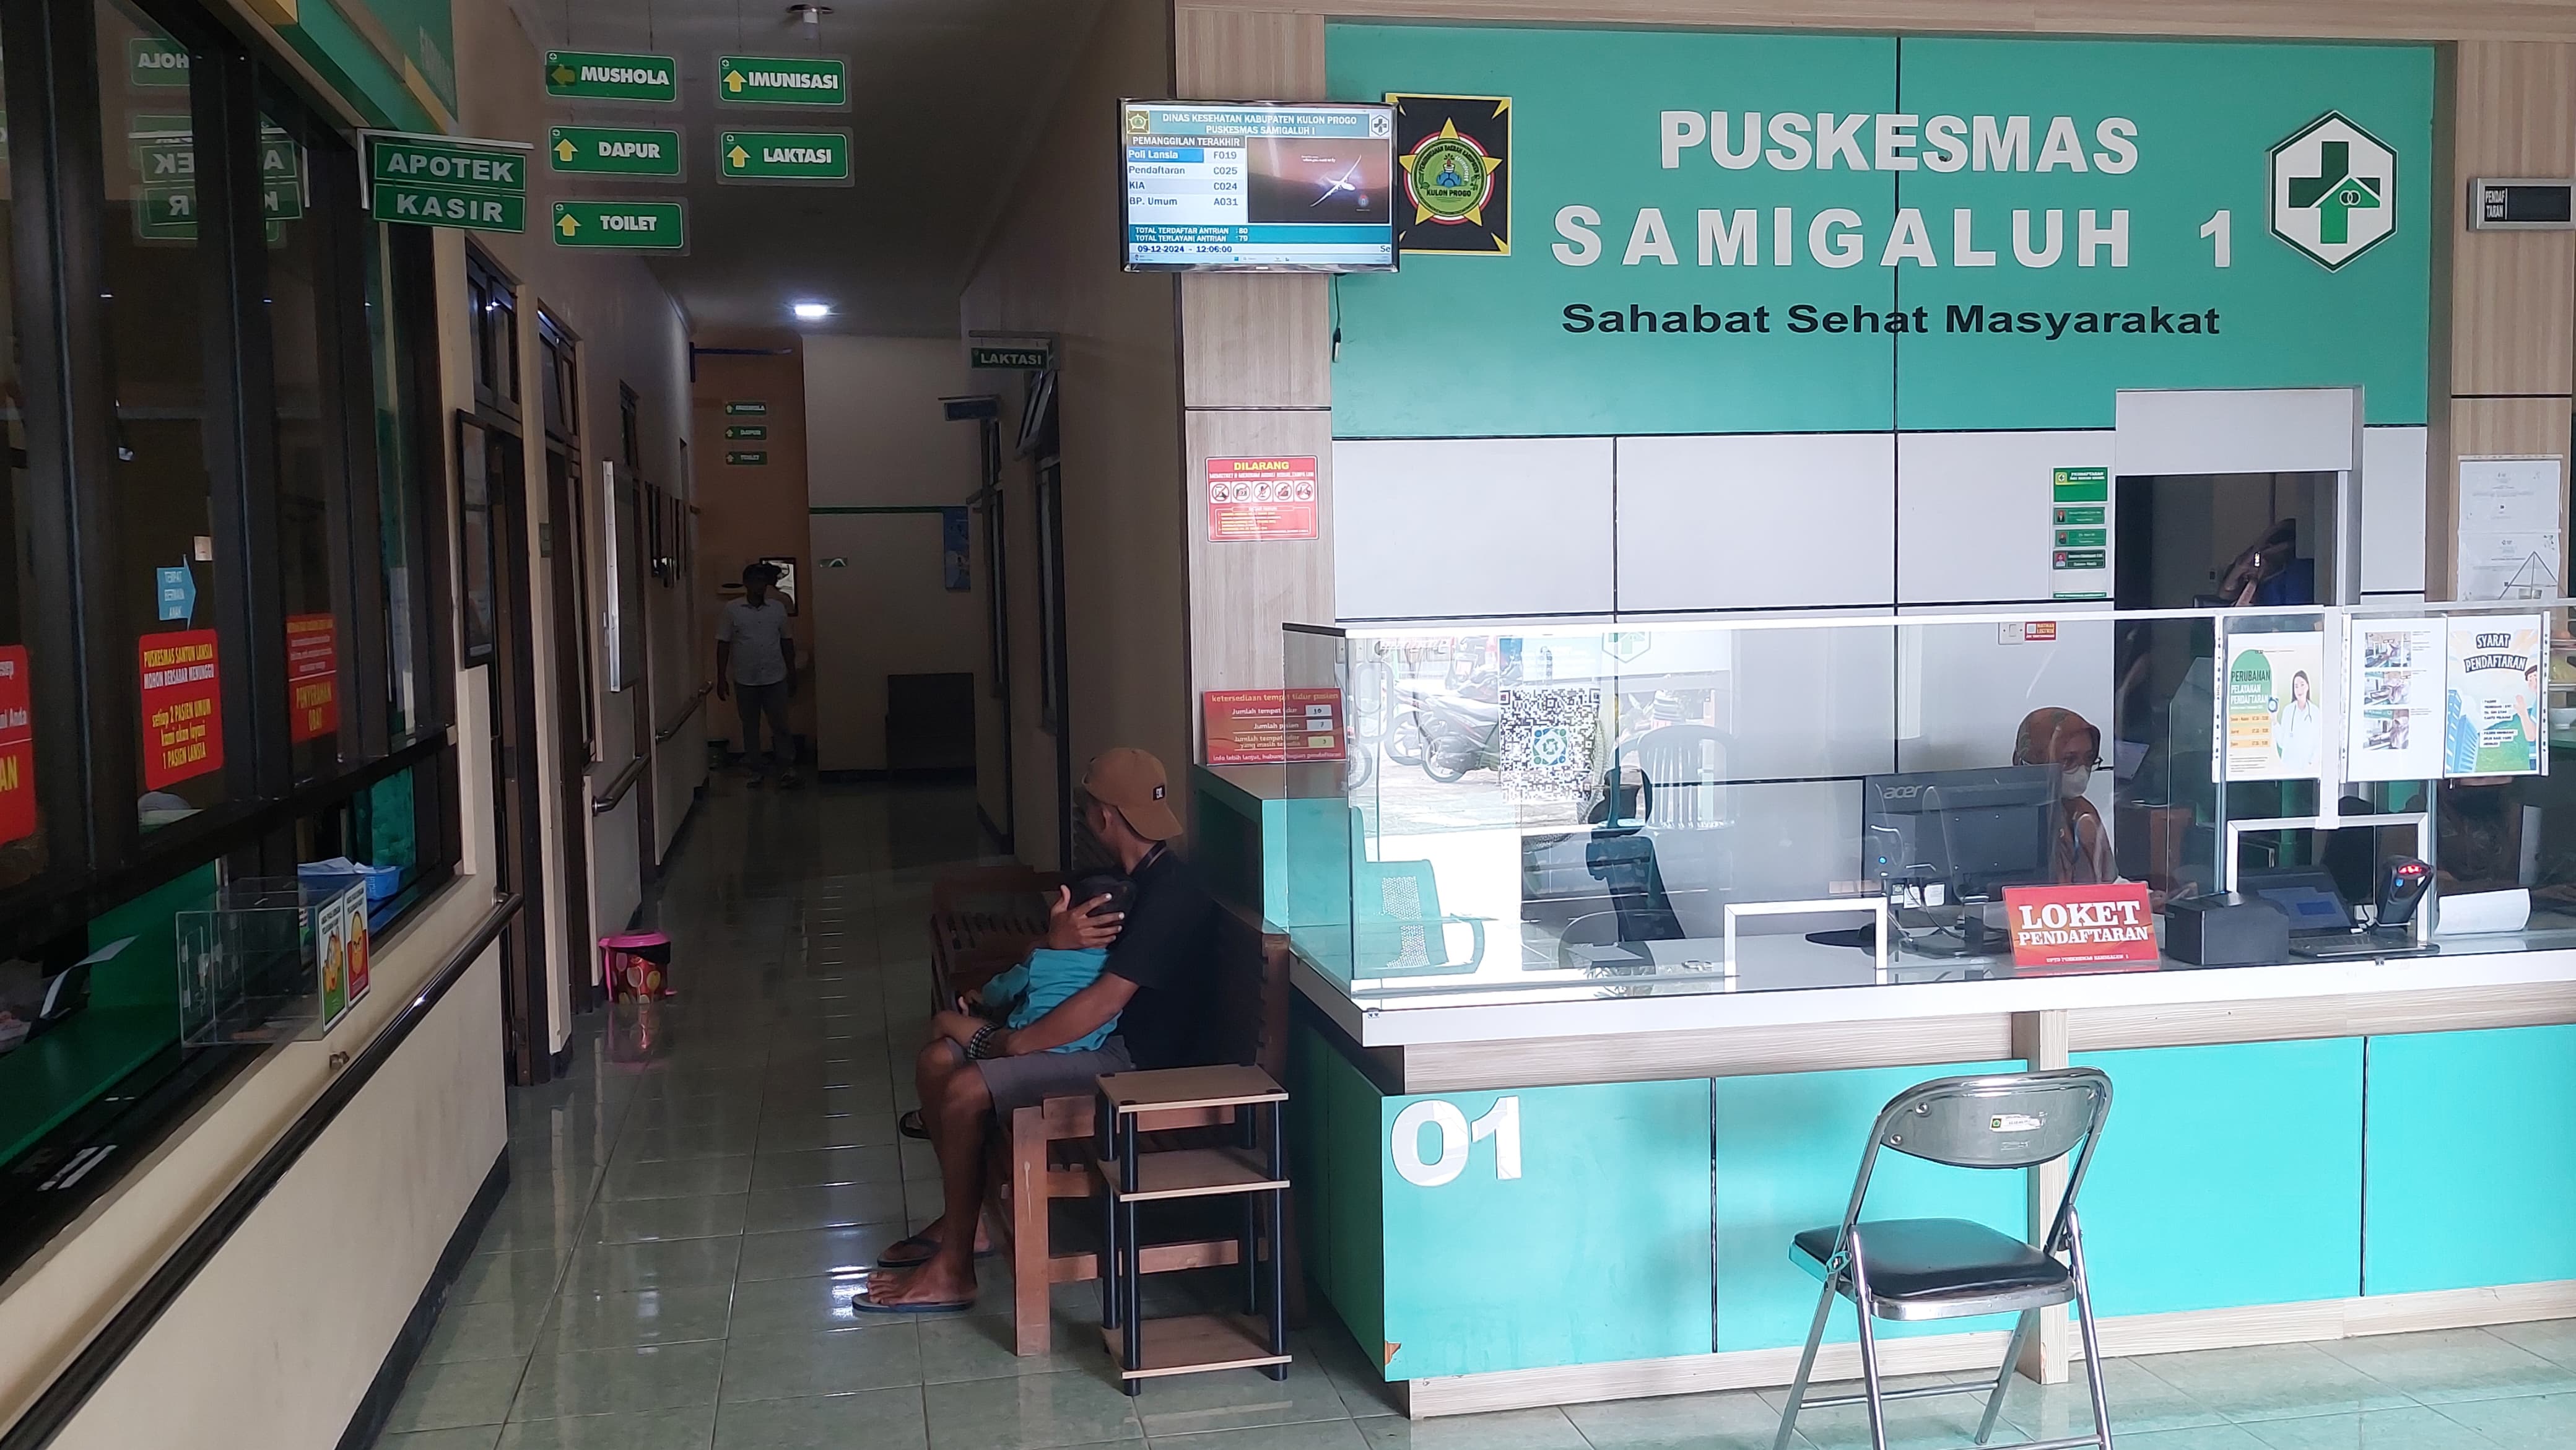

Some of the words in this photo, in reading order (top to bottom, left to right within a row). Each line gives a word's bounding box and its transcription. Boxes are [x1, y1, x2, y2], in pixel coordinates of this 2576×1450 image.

[581, 66, 670, 86] MUSHOLA
[749, 72, 838, 90] IMUNISASI
[1162, 114, 1190, 123] DINAS
[1192, 115, 1242, 123] KESEHATAN
[1245, 115, 1292, 124] KABUPATEN
[1297, 116, 1325, 124] KULON
[1328, 116, 1357, 124] PROGO
[1206, 125, 1258, 134] PUSKESMAS
[598, 141, 661, 158] DAPUR
[1133, 136, 1195, 145] PEMANGGILAN
[1197, 137, 1240, 147] TERAKHIR
[1660, 110, 2138, 174] PUSKESMAS
[763, 147, 832, 163] LAKTASI
[1214, 151, 1237, 160] F019
[386, 152, 515, 183] APOTEK
[1128, 165, 1185, 175] Pendaftaran
[1214, 167, 1238, 175] C025
[1129, 181, 1146, 189] KIA
[1214, 182, 1238, 190] C024
[1129, 197, 1145, 205] BP.
[1147, 198, 1178, 206] Umum
[2485, 190, 2505, 204] PENDAF
[396, 193, 504, 223] KASIR
[2486, 205, 2504, 217] TARAN
[600, 215, 657, 232] TOILET
[1551, 205, 2130, 268] SAMIGALUH
[2200, 209, 2231, 268] 1
[1137, 245, 1185, 253] 09-12-2024
[1196, 245, 1232, 253] 12:06:00
[1562, 304, 1770, 334] Sahabat
[1787, 305, 1928, 334] Sehat
[1946, 305, 2220, 341] Masyarakat
[980, 352, 1042, 365] LAKTASI
[1234, 461, 1289, 471] DILARANG
[2476, 633, 2510, 648] SYARAT
[2464, 654, 2527, 672] PENDAFTARAN
[2230, 670, 2270, 682] PERUBAHAN
[1212, 693, 1261, 702] ketersediaan
[170, 705, 174, 723] 2
[162, 752, 167, 770] 1
[1884, 783, 1923, 799] acer
[2018, 900, 2140, 929] LOKET
[2017, 926, 2149, 947] PENDAFTARAN
[1391, 1095, 1522, 1187] 01
